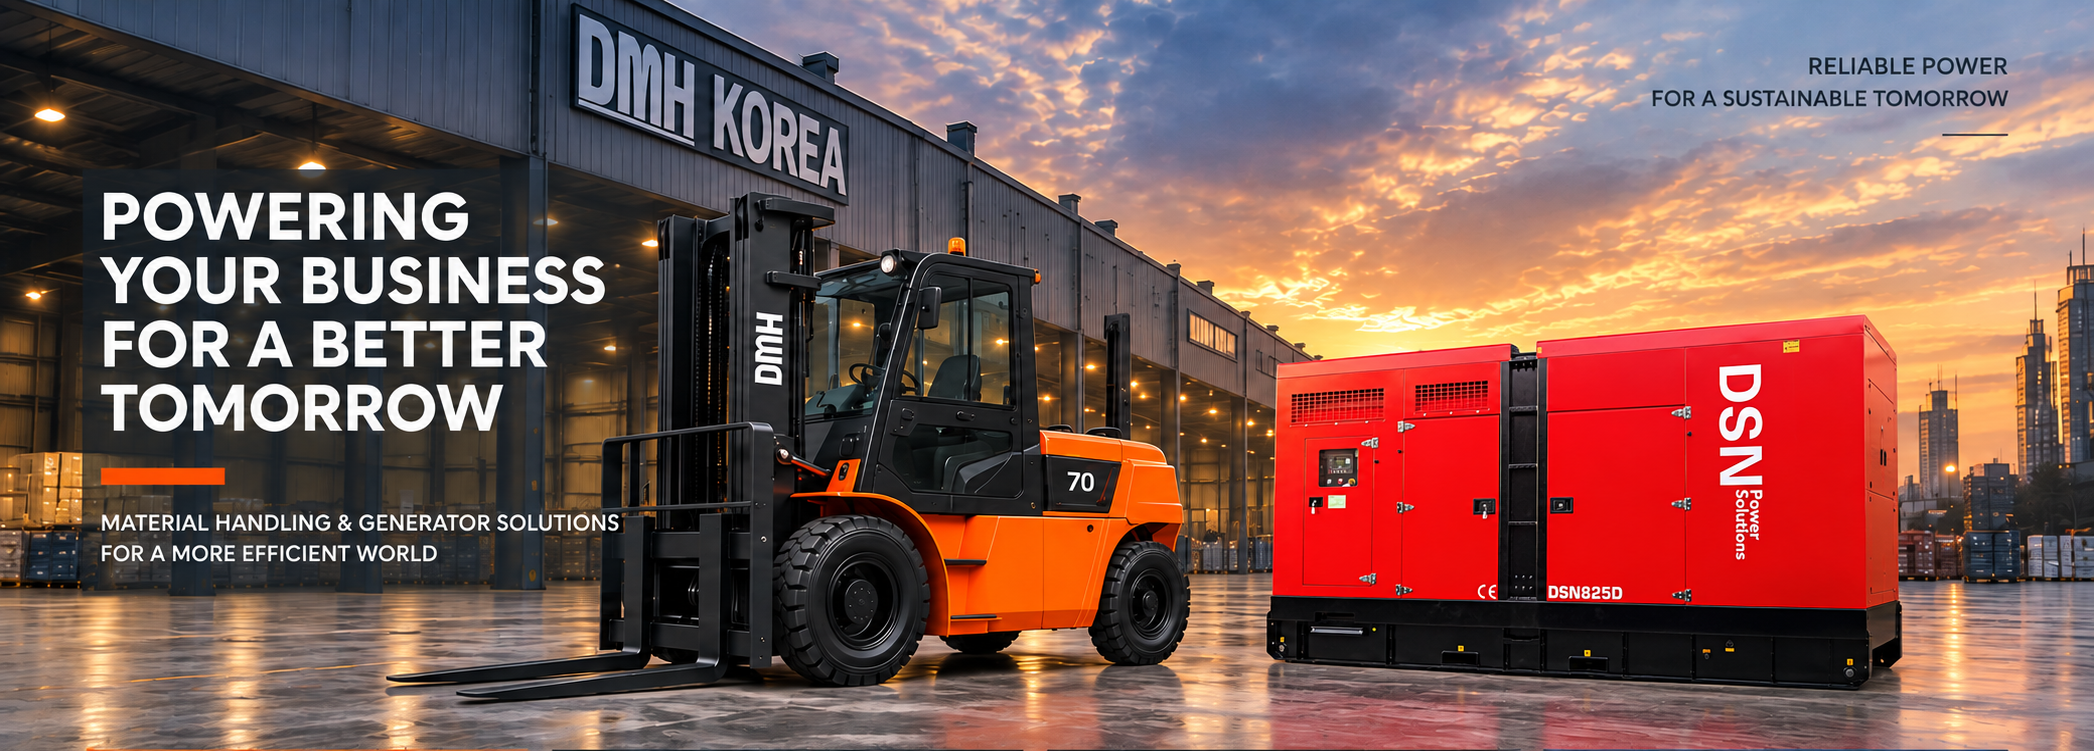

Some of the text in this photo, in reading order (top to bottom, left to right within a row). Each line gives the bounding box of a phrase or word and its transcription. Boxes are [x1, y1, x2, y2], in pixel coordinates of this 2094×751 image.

[577, 13, 848, 197] DMH KOREA
[754, 311, 783, 386] DMH
[1718, 363, 1763, 486] DSN
[1067, 471, 1095, 492] 70
[1735, 489, 1749, 560] Solutions
[1748, 489, 1763, 541] Power
[1477, 584, 1497, 600] CE
[1548, 585, 1623, 600] DSN825D
